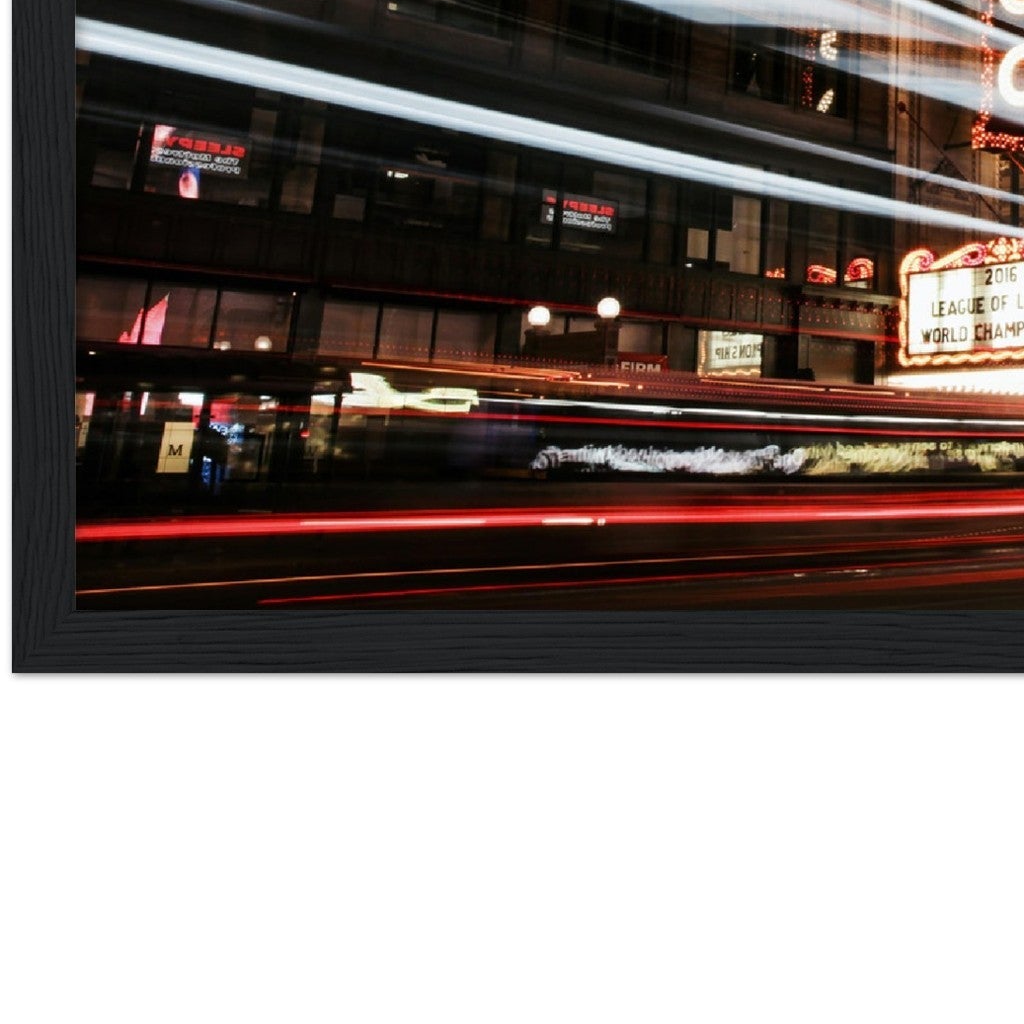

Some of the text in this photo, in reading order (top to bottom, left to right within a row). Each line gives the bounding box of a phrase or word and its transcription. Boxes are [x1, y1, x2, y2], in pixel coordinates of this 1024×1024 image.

[984, 266, 1018, 286] 2016
[931, 297, 985, 318] LEAGUE
[990, 294, 1009, 312] OF
[921, 326, 968, 345] WORLD
[168, 444, 183, 456] M
